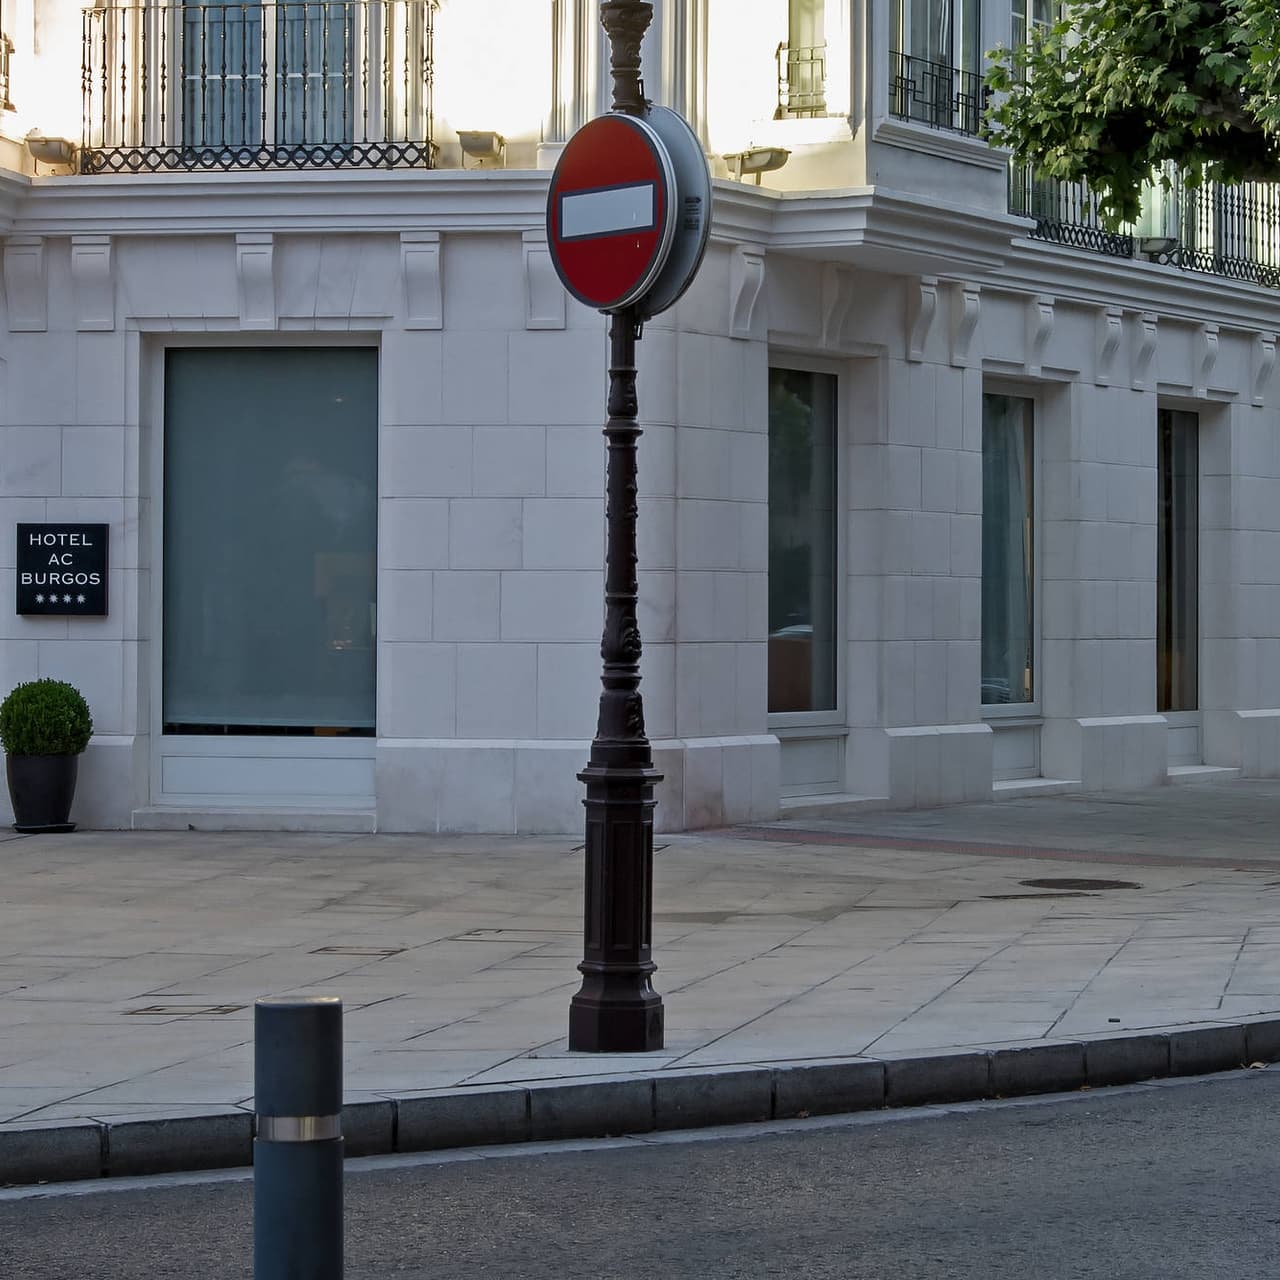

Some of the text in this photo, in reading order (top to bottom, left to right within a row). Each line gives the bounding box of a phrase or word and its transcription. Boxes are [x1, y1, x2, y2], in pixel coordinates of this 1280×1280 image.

[29, 533, 93, 546] HOTEL
[48, 553, 73, 566] AC
[21, 572, 100, 585] BURGOS
